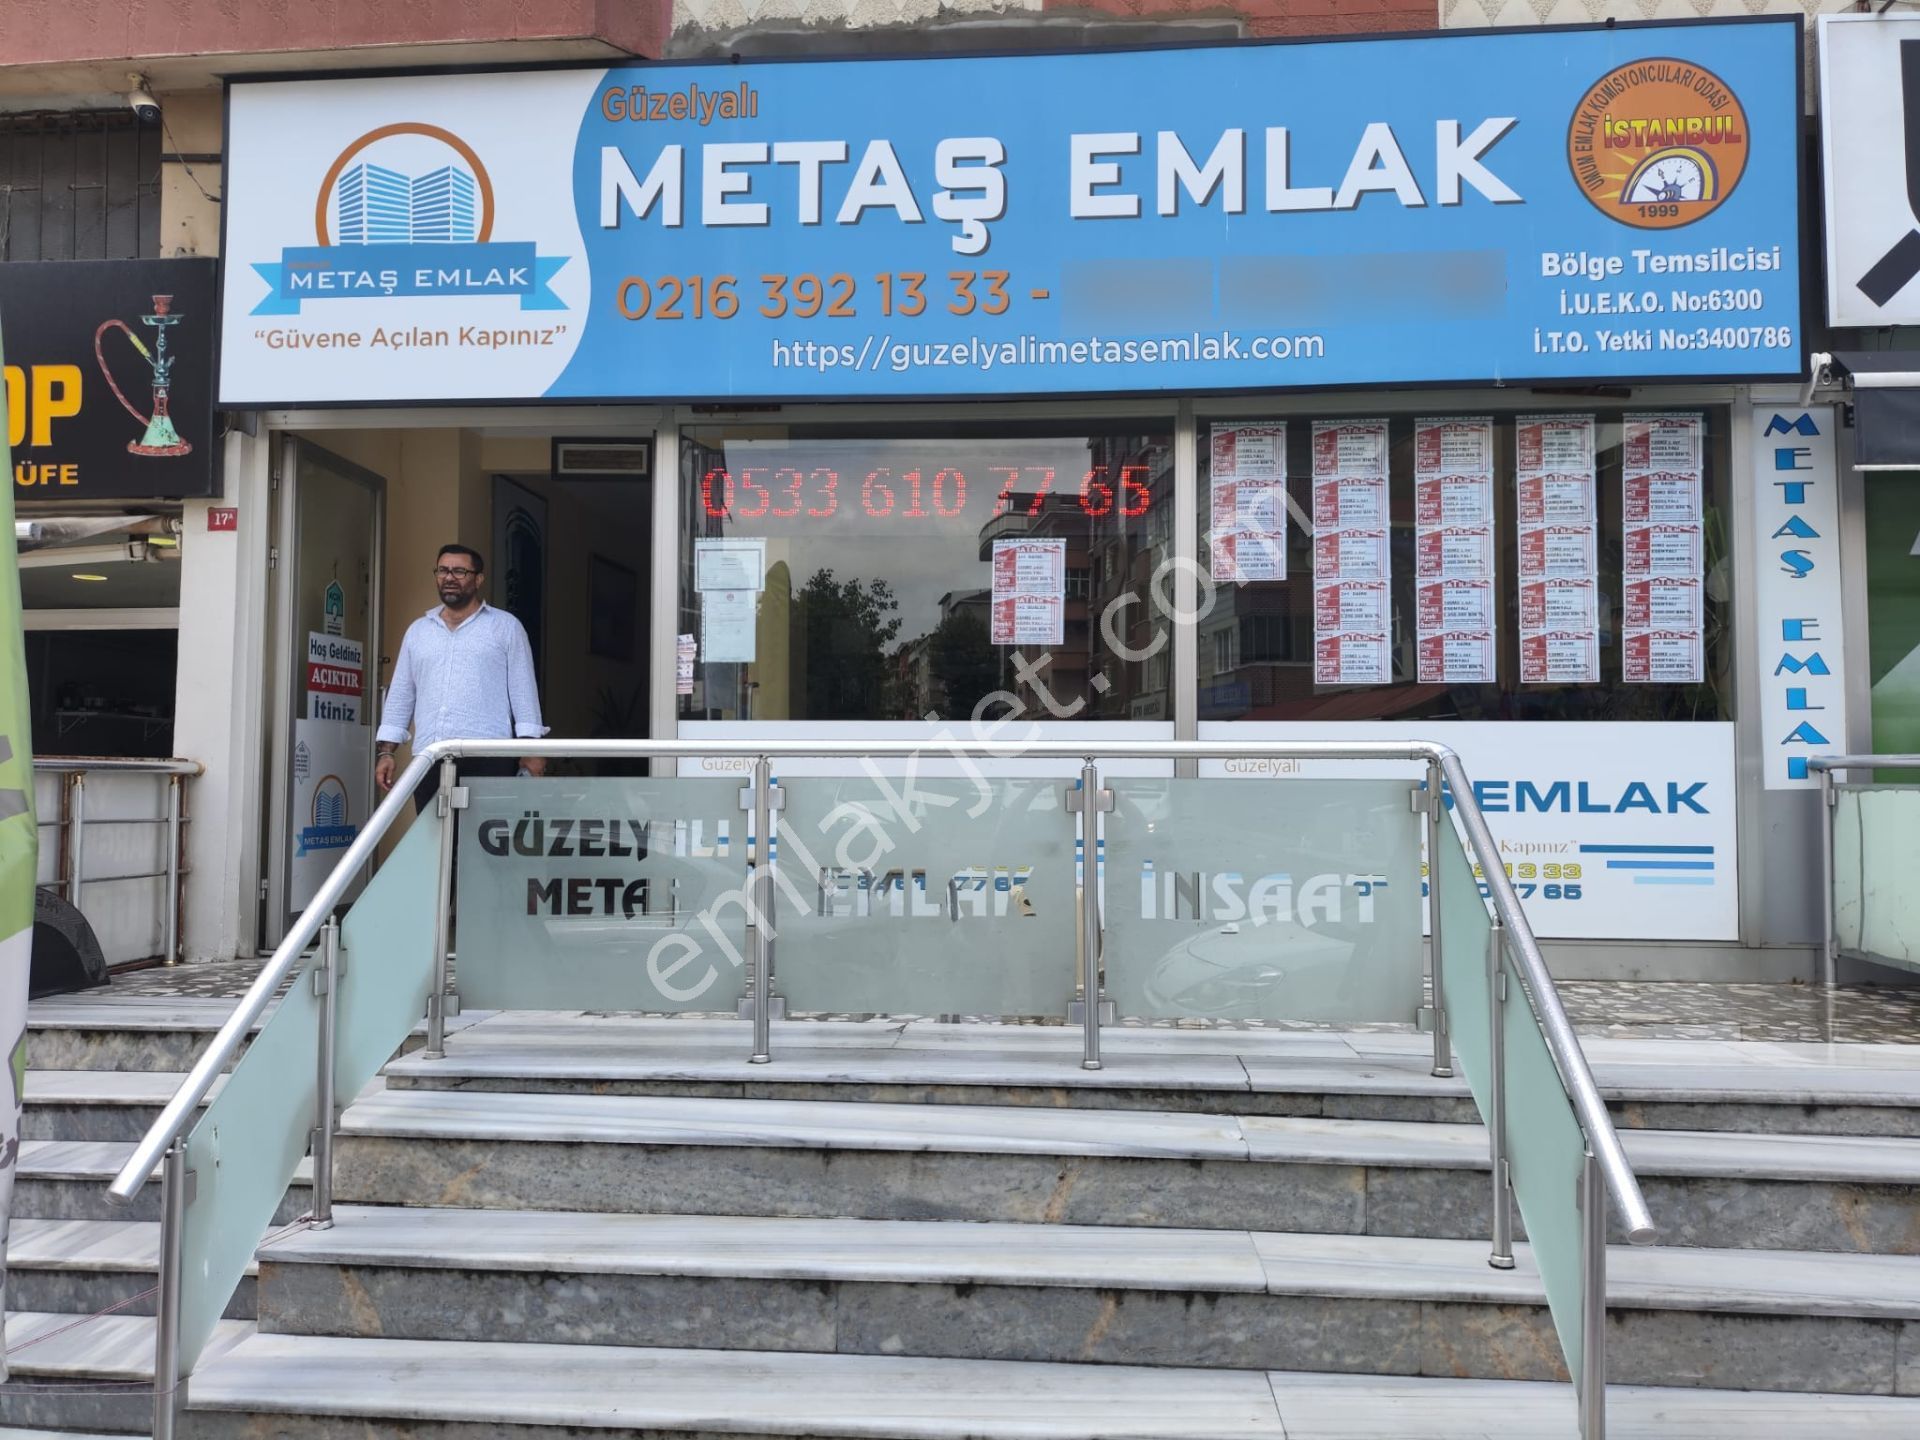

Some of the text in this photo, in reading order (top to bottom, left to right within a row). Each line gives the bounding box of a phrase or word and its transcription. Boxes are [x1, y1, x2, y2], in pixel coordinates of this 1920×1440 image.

[602, 81, 758, 125] Güzelyalı
[1575, 109, 1600, 152] EMLAK
[1603, 113, 1742, 148] İSTANBUL
[600, 117, 1524, 255] METAŞ EMLAK
[1637, 204, 1679, 217] 1999
[1541, 246, 1781, 281] Bölge Temsilcisi
[289, 267, 529, 294] METAŞ EMLAK
[616, 275, 740, 320] 0216
[759, 273, 856, 318] 392
[876, 272, 927, 316] 13
[947, 270, 1011, 315] 33
[1671, 288, 1764, 313] No:6300
[370, 325, 449, 350] Açılan
[1534, 326, 1793, 353] İ.T.O. Yetki No:3400786
[772, 332, 1325, 372] https//guzelyalimetasemlak.com
[701, 467, 839, 517] 0533
[861, 467, 966, 517] 610
[987, 467, 1056, 517] 77
[1079, 466, 1153, 516] 65
[310, 638, 361, 664] Hoş Geldiniz
[311, 667, 359, 689] AÇIKTIR
[314, 695, 356, 722] İtiniz
[1473, 781, 1710, 814] EMLAK
[1543, 863, 1582, 880] 33
[1543, 883, 1582, 900] 65
